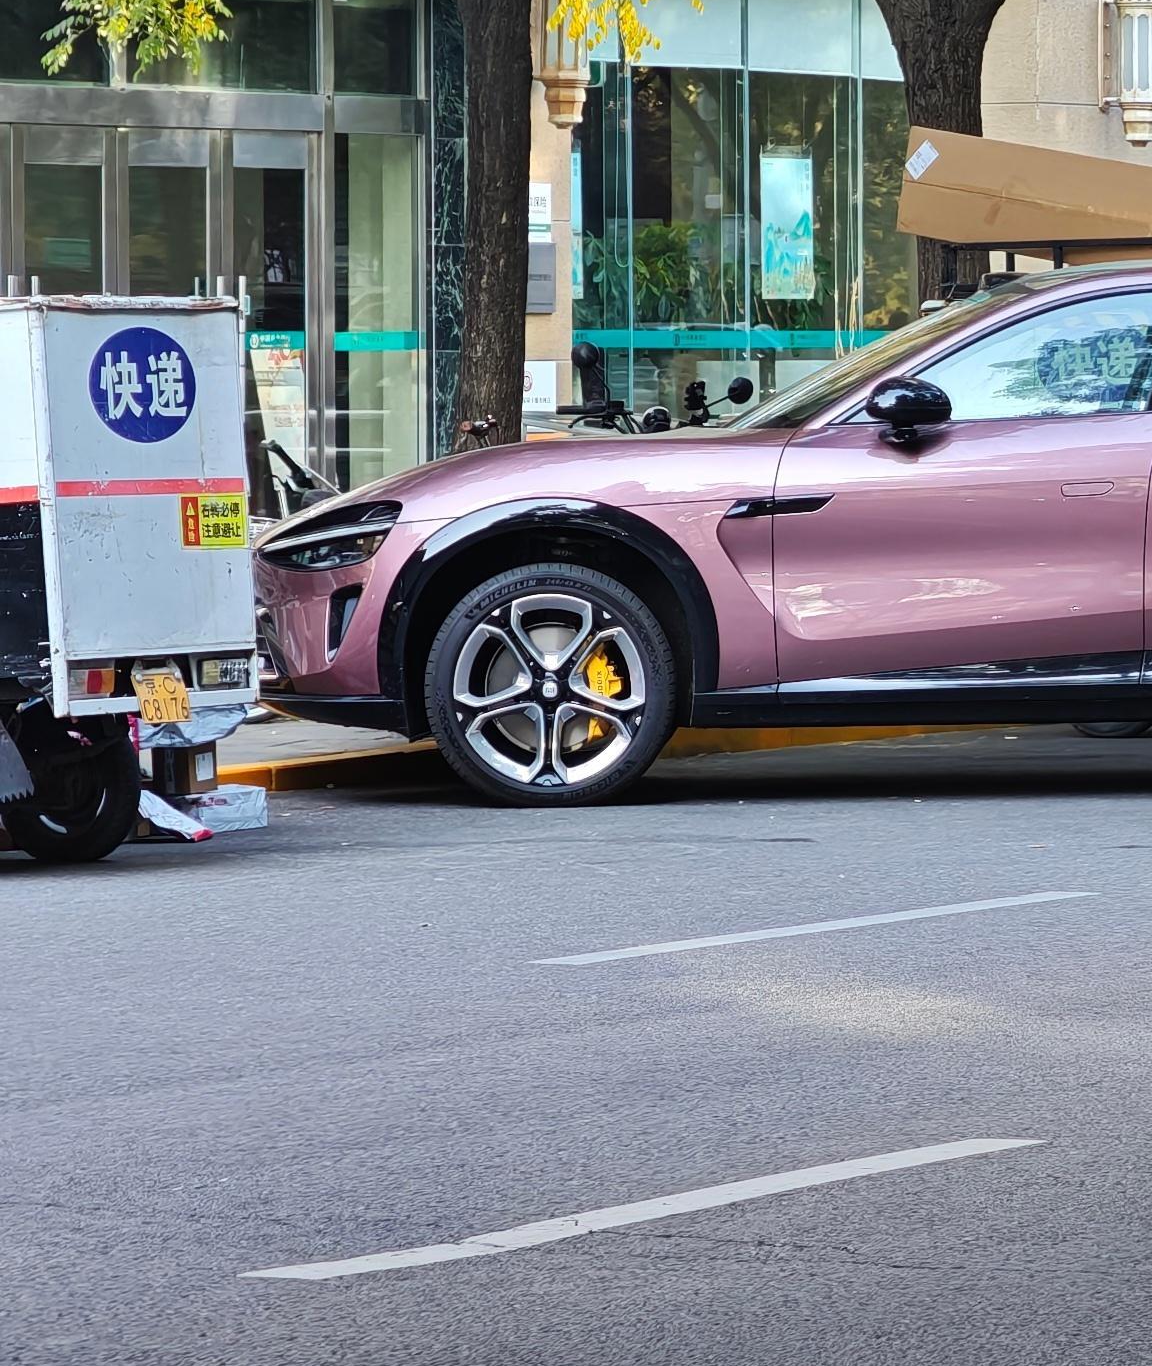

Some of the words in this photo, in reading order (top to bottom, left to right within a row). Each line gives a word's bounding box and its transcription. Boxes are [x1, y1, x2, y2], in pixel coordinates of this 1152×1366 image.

[99, 351, 188, 419] 快递
[201, 501, 240, 518] 右转必停
[202, 522, 241, 538] 注意避让
[480, 579, 537, 610] MICHELIN
[143, 697, 189, 721] C8176
